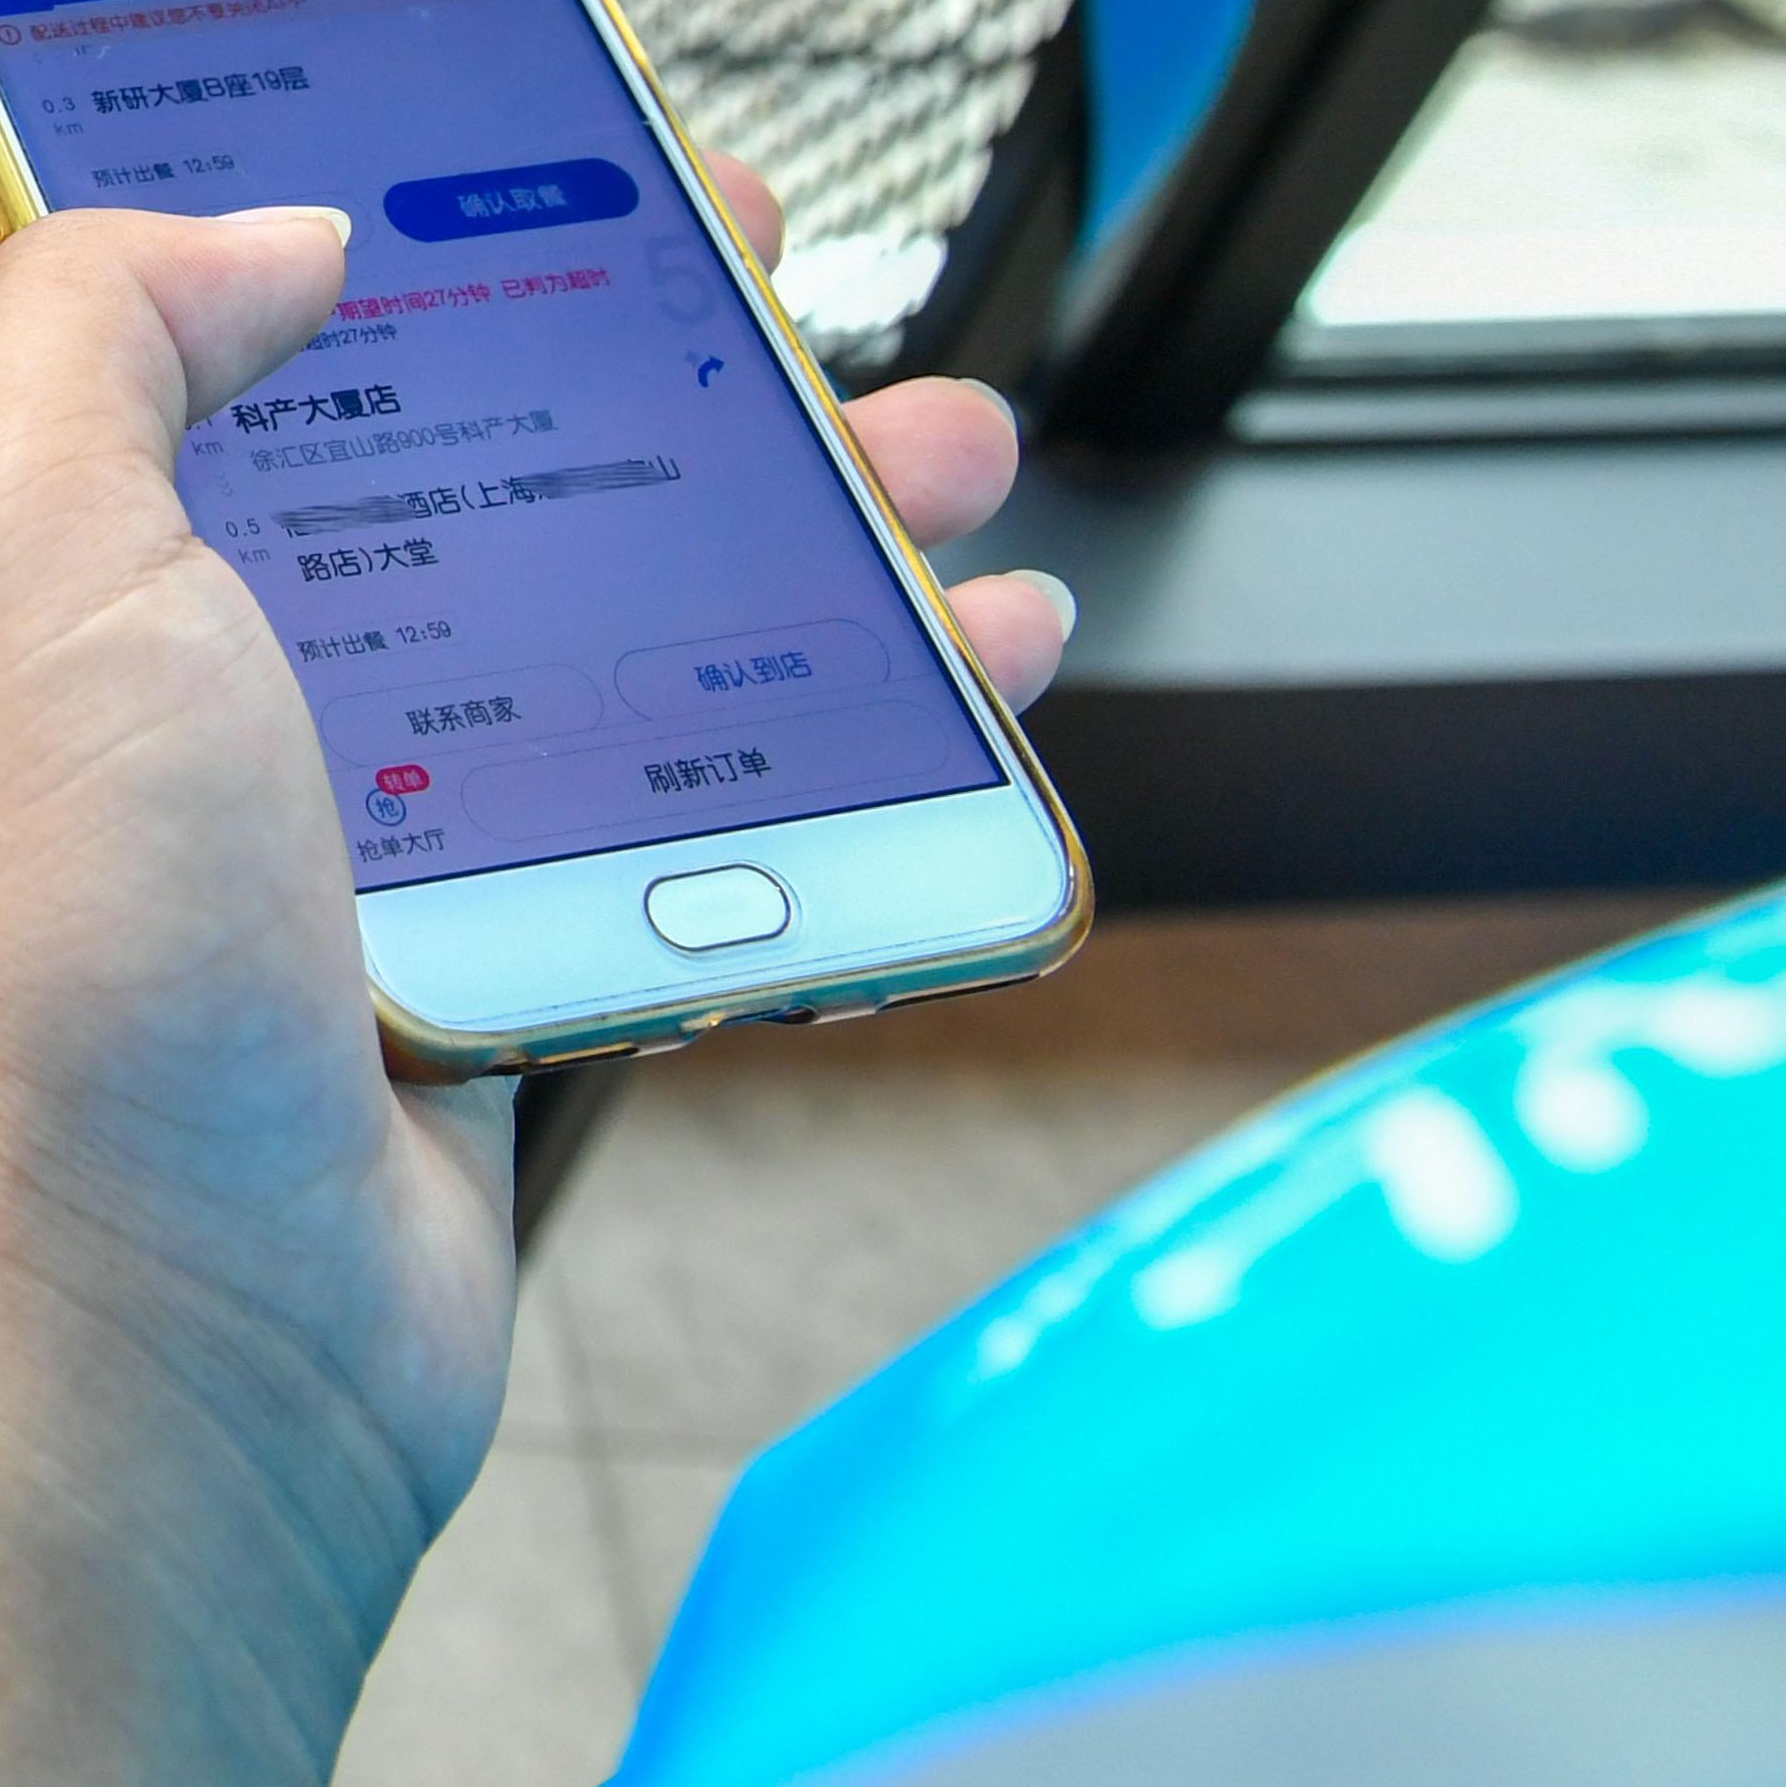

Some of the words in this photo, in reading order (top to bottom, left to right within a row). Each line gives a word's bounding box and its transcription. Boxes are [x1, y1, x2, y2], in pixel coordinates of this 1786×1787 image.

[41, 97, 76, 115] 0.3
[92, 65, 312, 116] 新研大厦B座19层
[331, 282, 491, 322] 期望时间27分钟
[501, 267, 611, 302] 已判为超时
[230, 383, 402, 436] 科产大厦店
[192, 439, 224, 457] km
[250, 408, 560, 474] 徐汇区宜山路900号科产大厦
[225, 518, 261, 539] 0.5
[238, 547, 272, 564] km
[295, 537, 440, 583] 路店)大堂
[296, 632, 389, 663] 预计出餐
[395, 619, 452, 645] 12:59
[693, 650, 814, 694] 确认到店
[405, 695, 522, 737] 联系商家
[642, 747, 773, 795] 刷新订单
[355, 827, 446, 864] 抢单大厅
